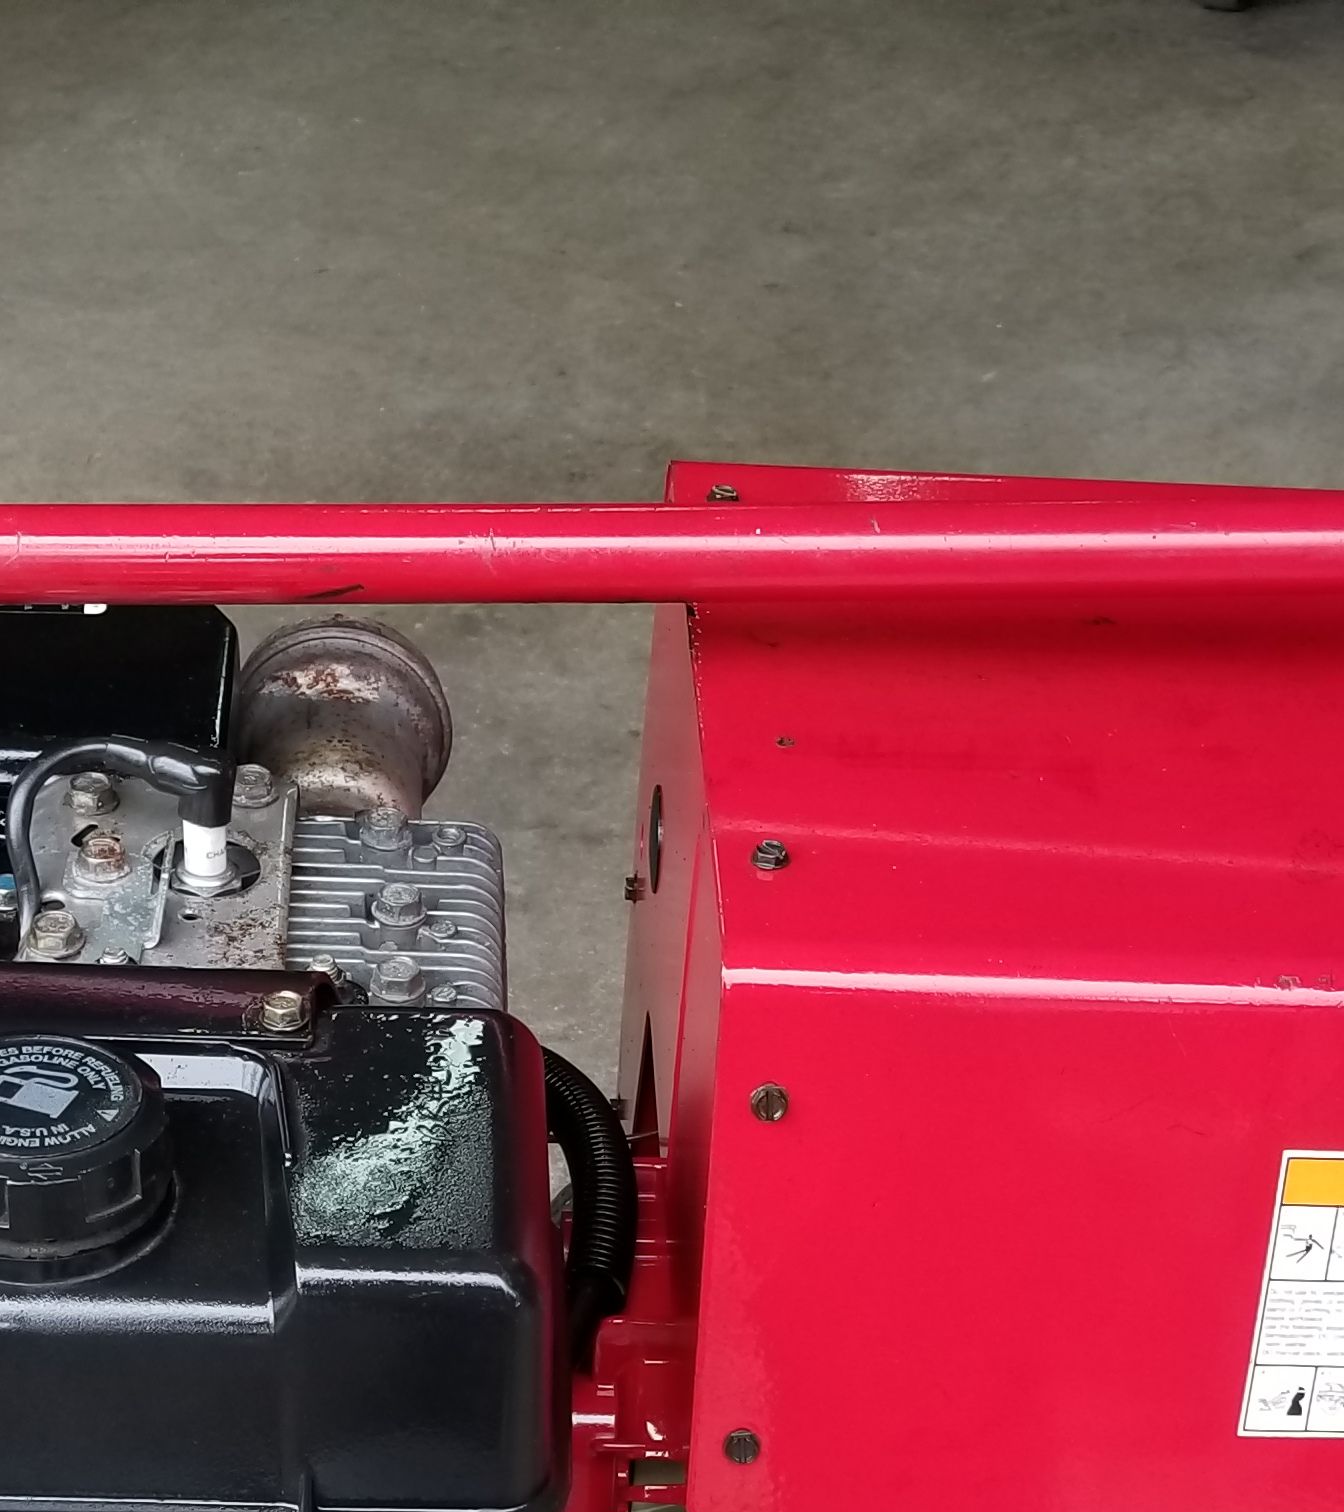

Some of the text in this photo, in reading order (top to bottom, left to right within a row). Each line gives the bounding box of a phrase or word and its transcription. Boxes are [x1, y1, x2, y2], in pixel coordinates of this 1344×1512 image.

[21, 1045, 85, 1061] BEFORE
[82, 1056, 124, 1101] REFUELING
[51, 1123, 70, 1135] IN
[77, 1066, 106, 1090] ONLY
[44, 1123, 96, 1146] ALLOW
